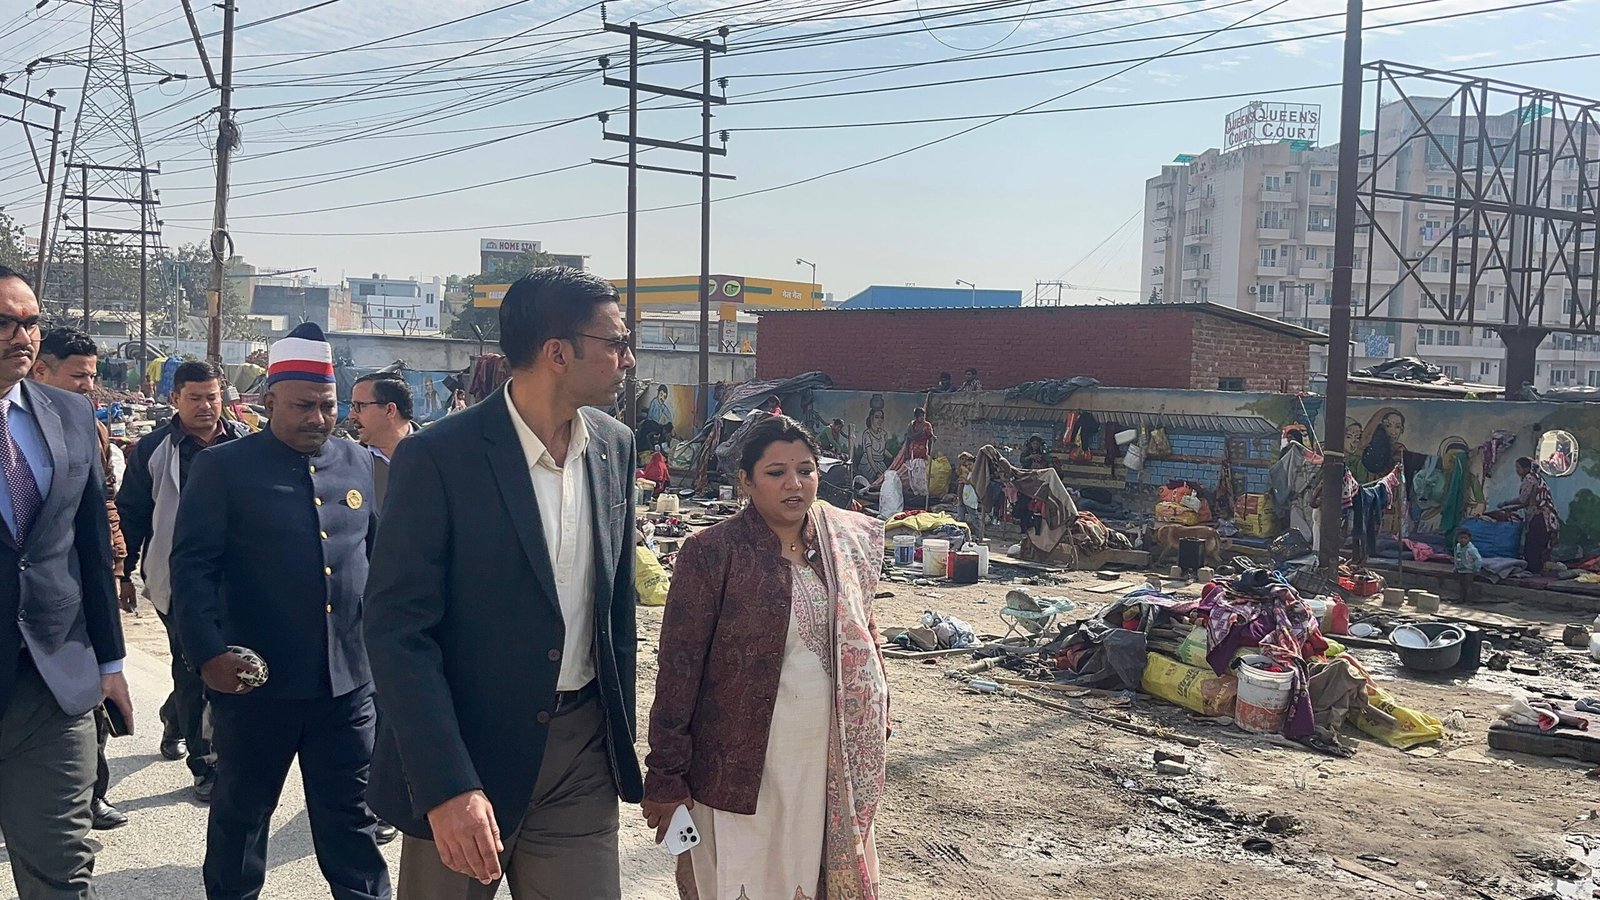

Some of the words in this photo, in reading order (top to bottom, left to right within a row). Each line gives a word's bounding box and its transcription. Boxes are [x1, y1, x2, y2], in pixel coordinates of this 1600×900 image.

[1253, 108, 1318, 123] QUEEN'S
[1229, 127, 1253, 146] COURT
[1263, 123, 1316, 138] COURT
[499, 242, 519, 250] HOME
[521, 243, 537, 251] STAY
